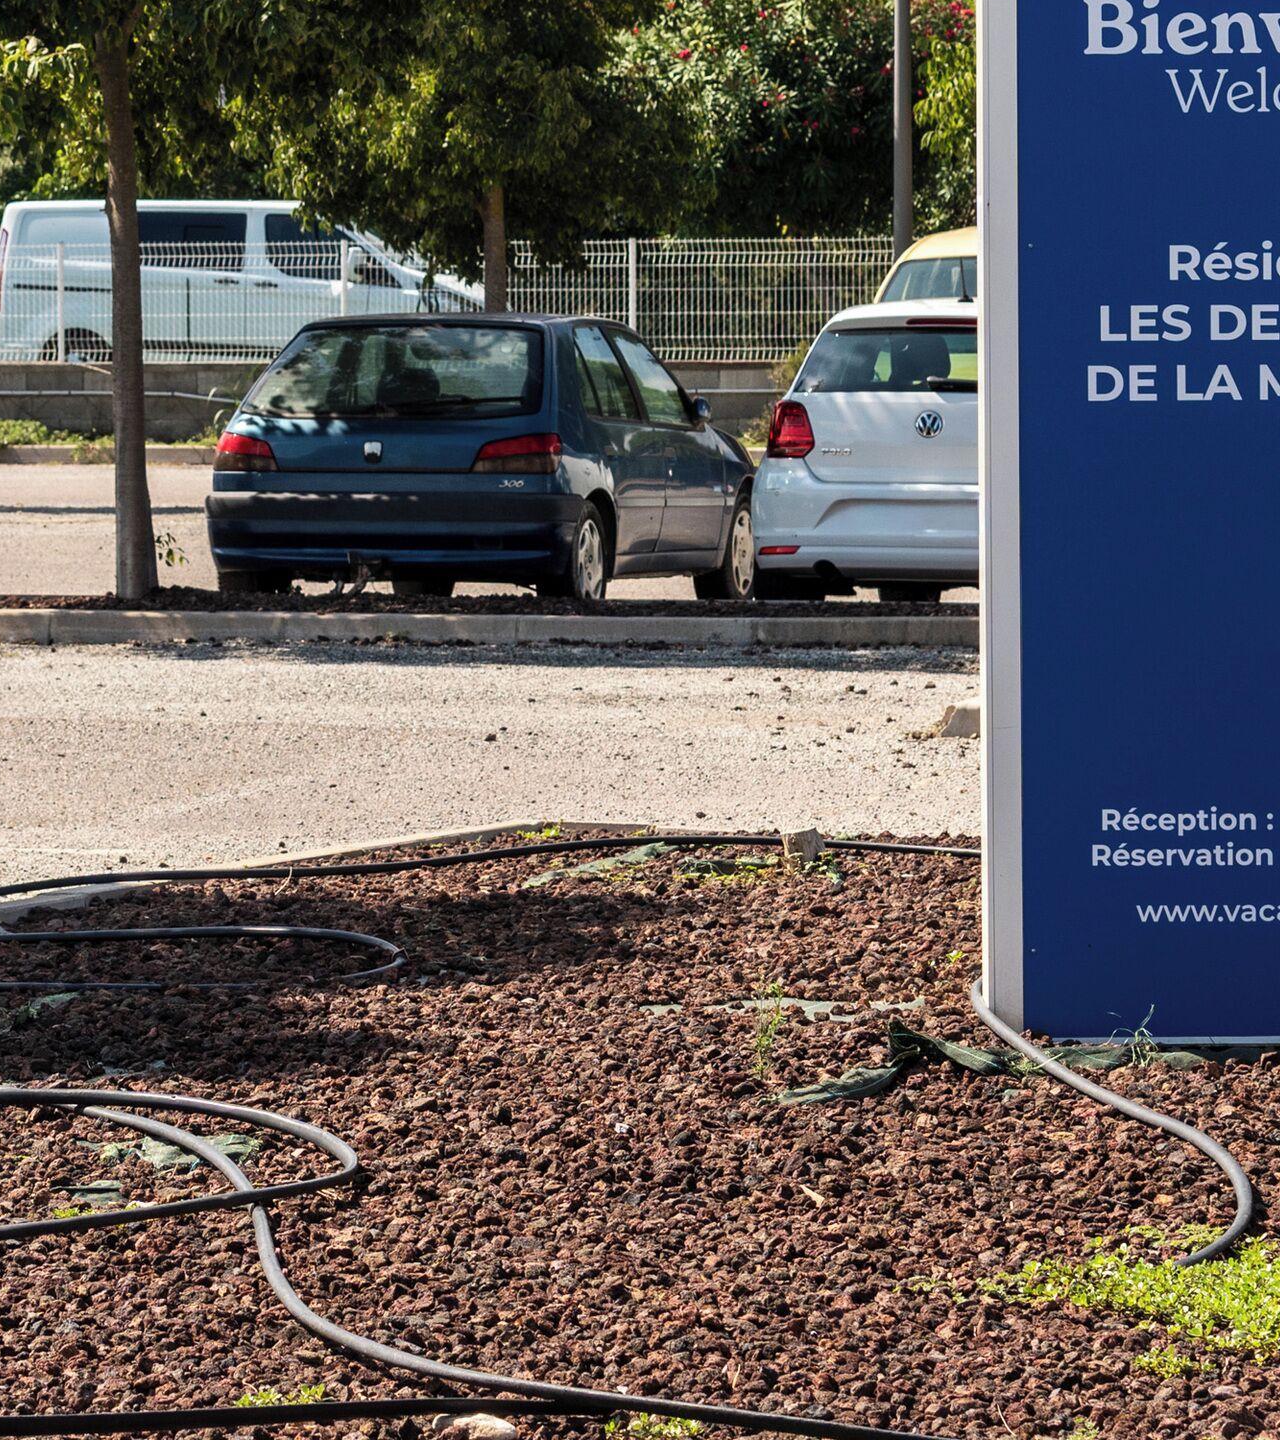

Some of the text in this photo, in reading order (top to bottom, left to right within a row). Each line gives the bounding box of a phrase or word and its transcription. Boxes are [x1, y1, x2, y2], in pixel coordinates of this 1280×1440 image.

[1100, 304, 1192, 342] LES
[1087, 364, 1158, 402] DE
[1176, 364, 1243, 401] LA
[1101, 807, 1257, 836] Réception
[1092, 842, 1273, 867] Réservation
